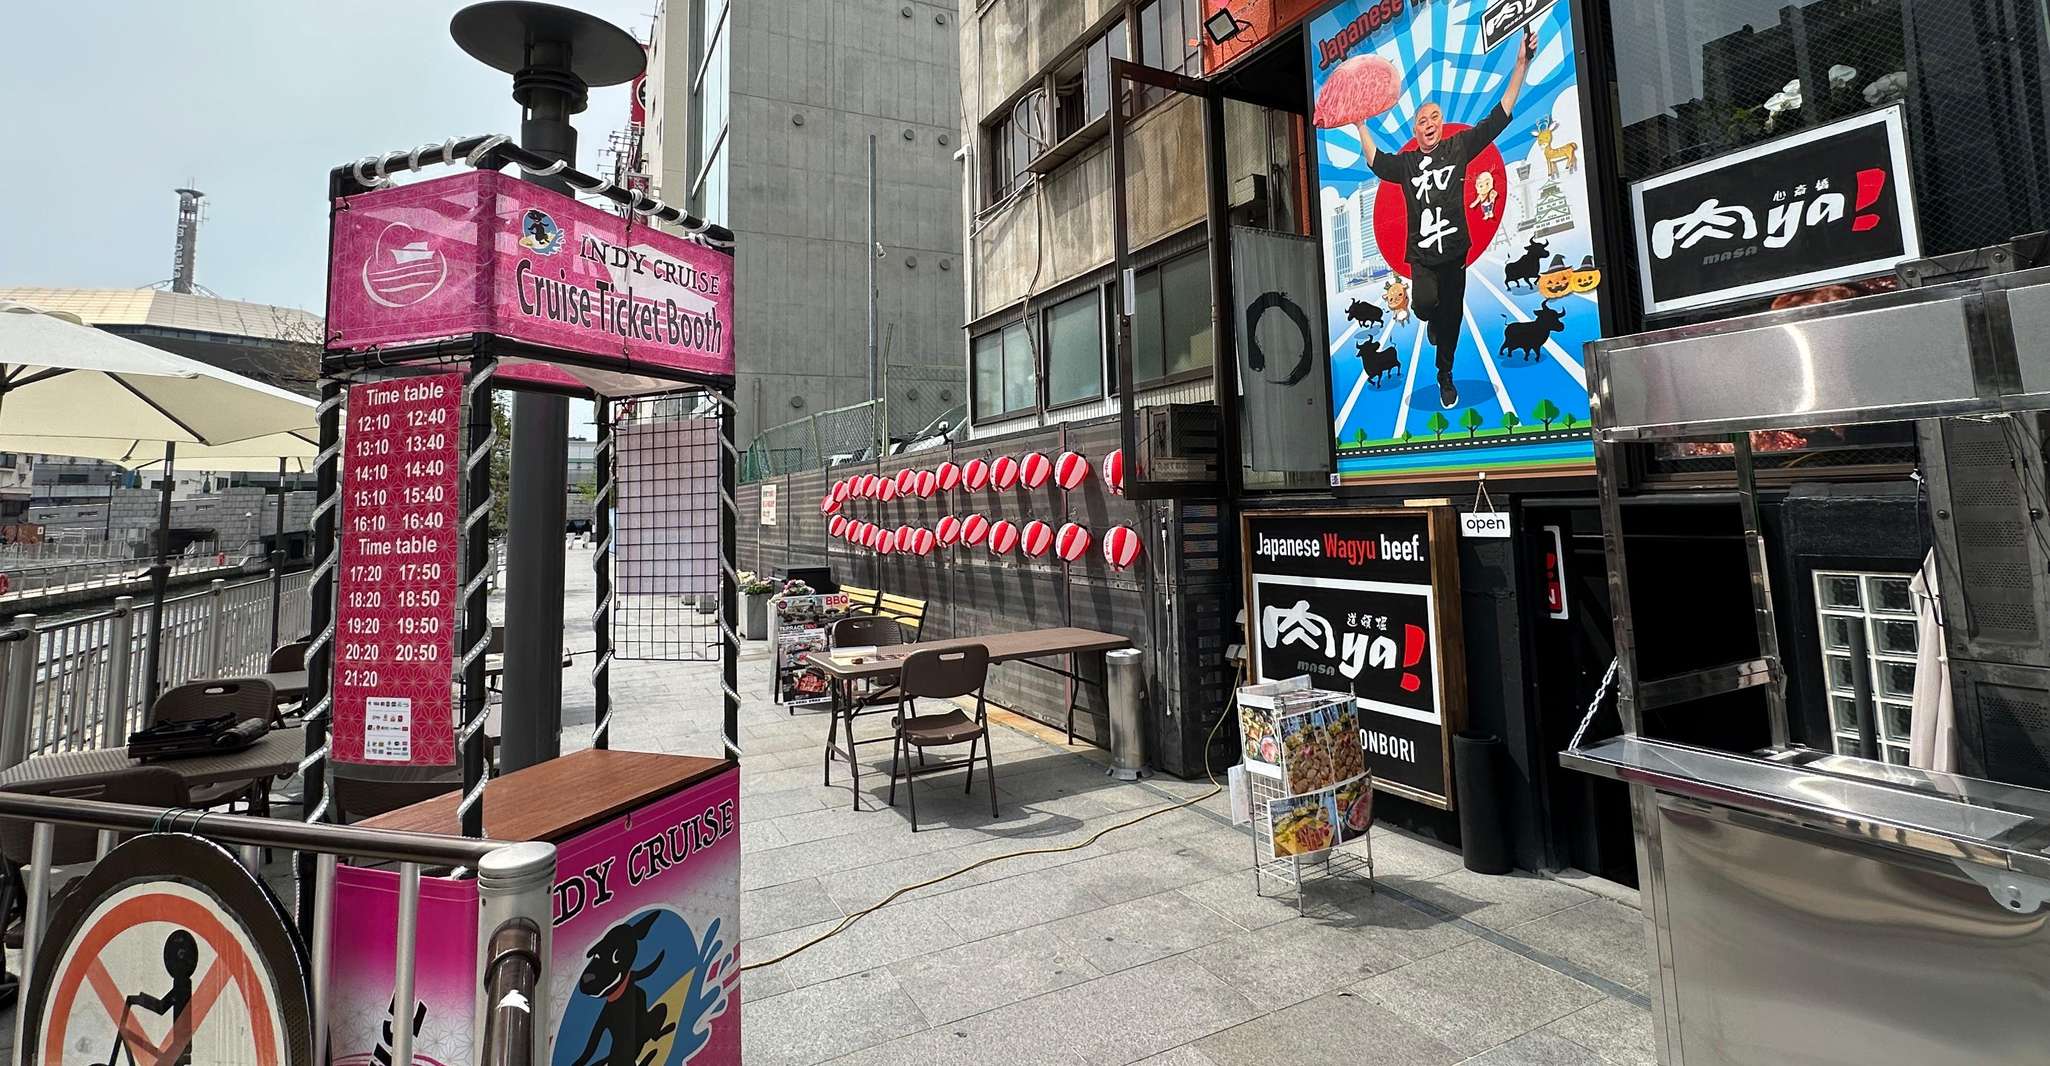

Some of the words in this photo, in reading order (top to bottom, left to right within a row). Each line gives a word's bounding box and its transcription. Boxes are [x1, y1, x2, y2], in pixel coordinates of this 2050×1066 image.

[1319, 0, 1403, 70] Japanese
[1411, 155, 1458, 254] 和牛
[579, 234, 646, 274] INDY
[653, 259, 721, 295] CRUISE
[516, 260, 592, 323] Cruise
[595, 281, 662, 342] Ticket
[666, 301, 723, 354] Booth
[366, 389, 400, 406] Time
[404, 382, 444, 401] table
[358, 414, 390, 432] 12:10
[407, 408, 446, 427] 12:40
[356, 439, 389, 456] 13:10
[406, 433, 445, 452] 13:40
[355, 464, 388, 481] 14:10
[404, 460, 444, 477] 14:40
[354, 489, 387, 507] 15:10
[403, 486, 444, 503] 15:40
[353, 515, 386, 532] 16:10
[402, 512, 443, 529] 16:40
[1466, 515, 1506, 533] open
[358, 538, 391, 556] Time
[396, 536, 437, 554] table
[1256, 532, 1320, 561] Japanese
[1323, 532, 1376, 566] Wagyu
[1380, 533, 1425, 562] beef.
[350, 565, 382, 582] 17:20
[399, 563, 441, 580] 17:50
[349, 591, 381, 608] 18:20
[398, 590, 440, 607] 18:50
[825, 595, 848, 605] BBQ
[347, 617, 380, 634] 19:20
[397, 617, 439, 634] 19:50
[345, 644, 379, 661] 20:20
[395, 644, 438, 661] 20:50
[344, 670, 378, 687] 21:20
[1359, 728, 1415, 763] ONBORI
[553, 856, 616, 927] DY
[627, 799, 734, 887] CRUISE
